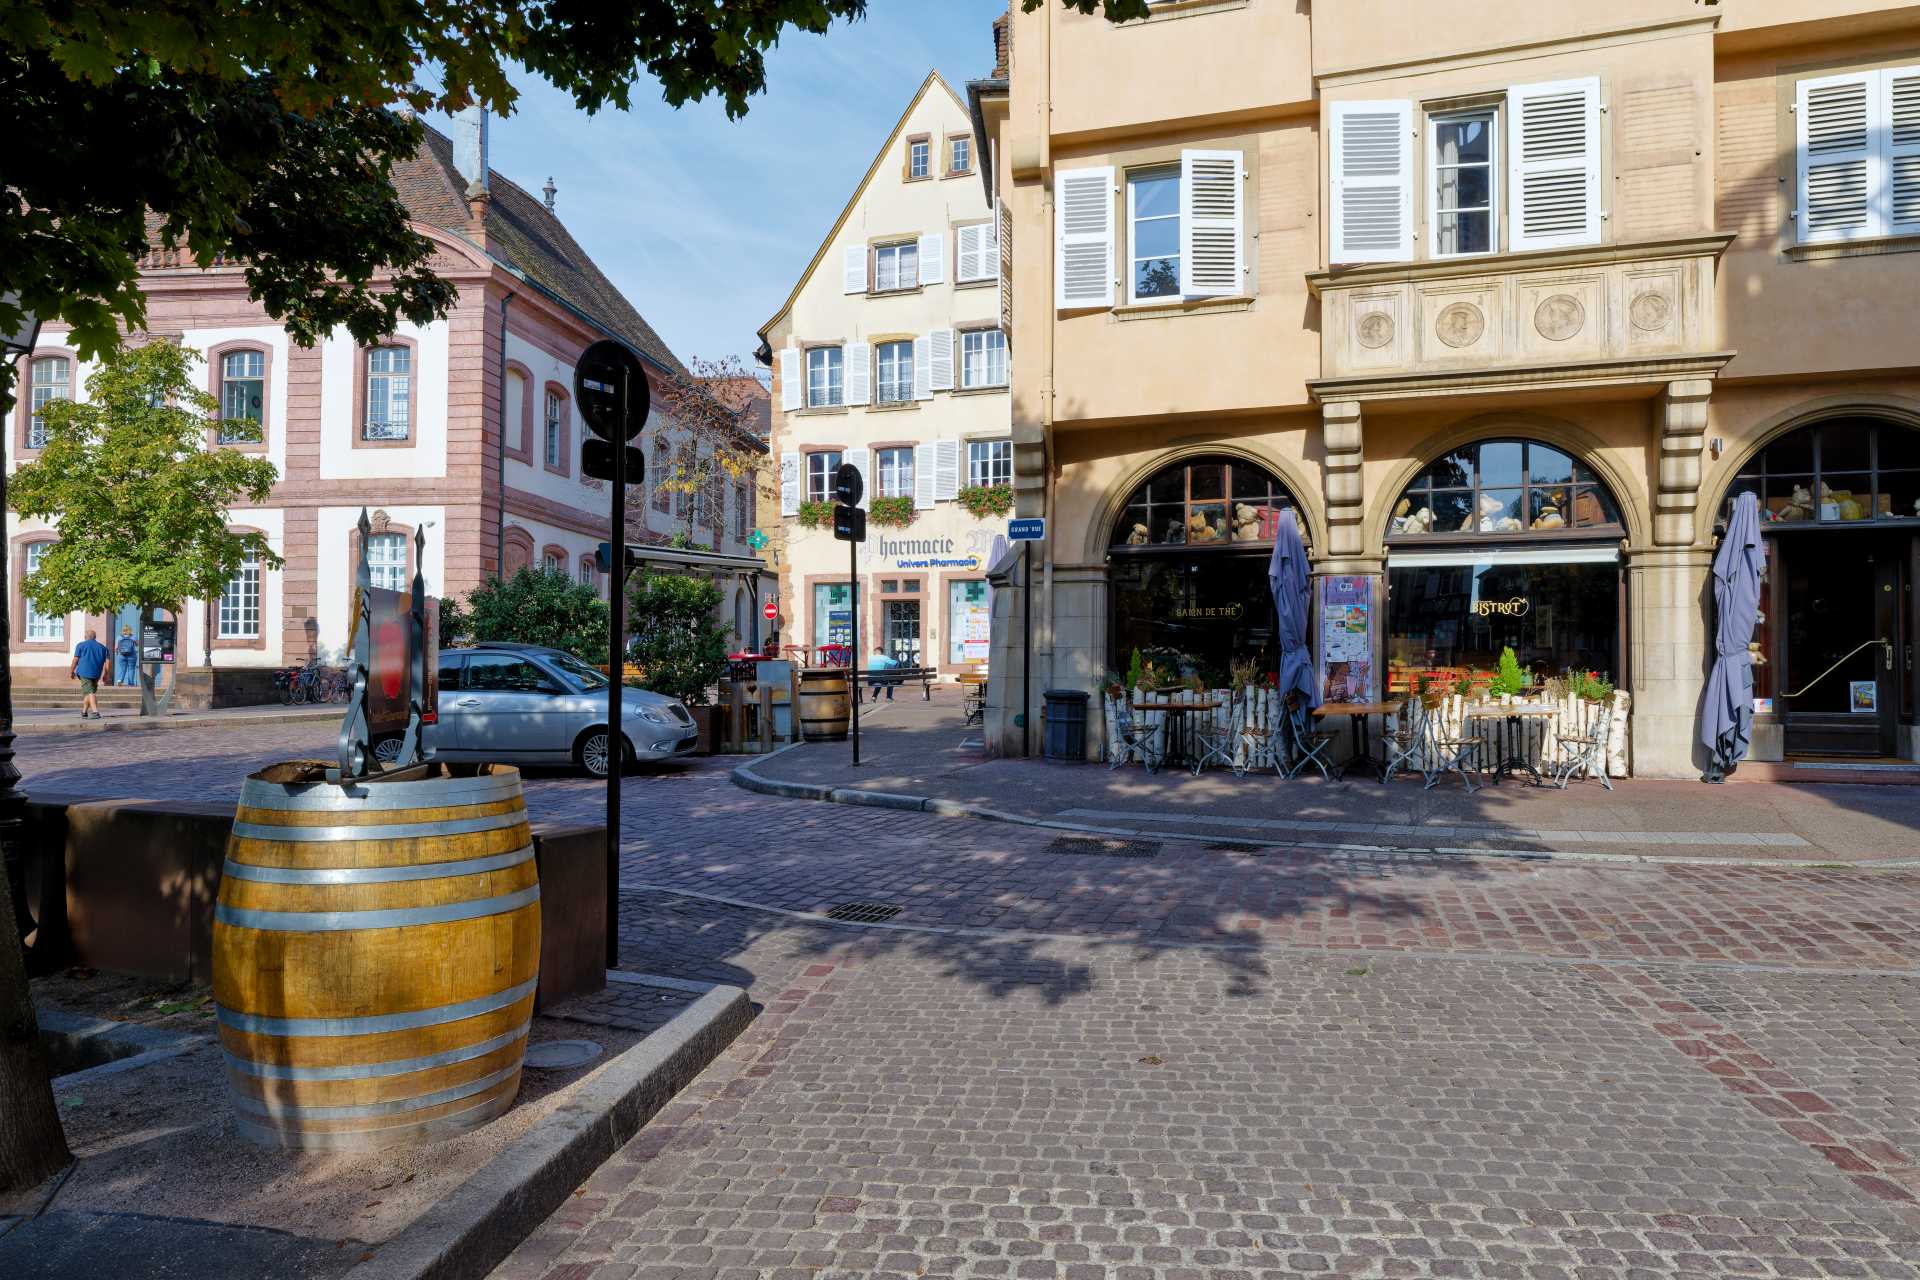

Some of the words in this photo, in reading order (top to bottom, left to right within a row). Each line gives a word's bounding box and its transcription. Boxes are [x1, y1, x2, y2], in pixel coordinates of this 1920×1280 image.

[897, 560, 928, 568] Univers
[930, 558, 977, 568] Pharmacie
[1205, 607, 1216, 616] DE
[1472, 602, 1521, 616] BISTROT
